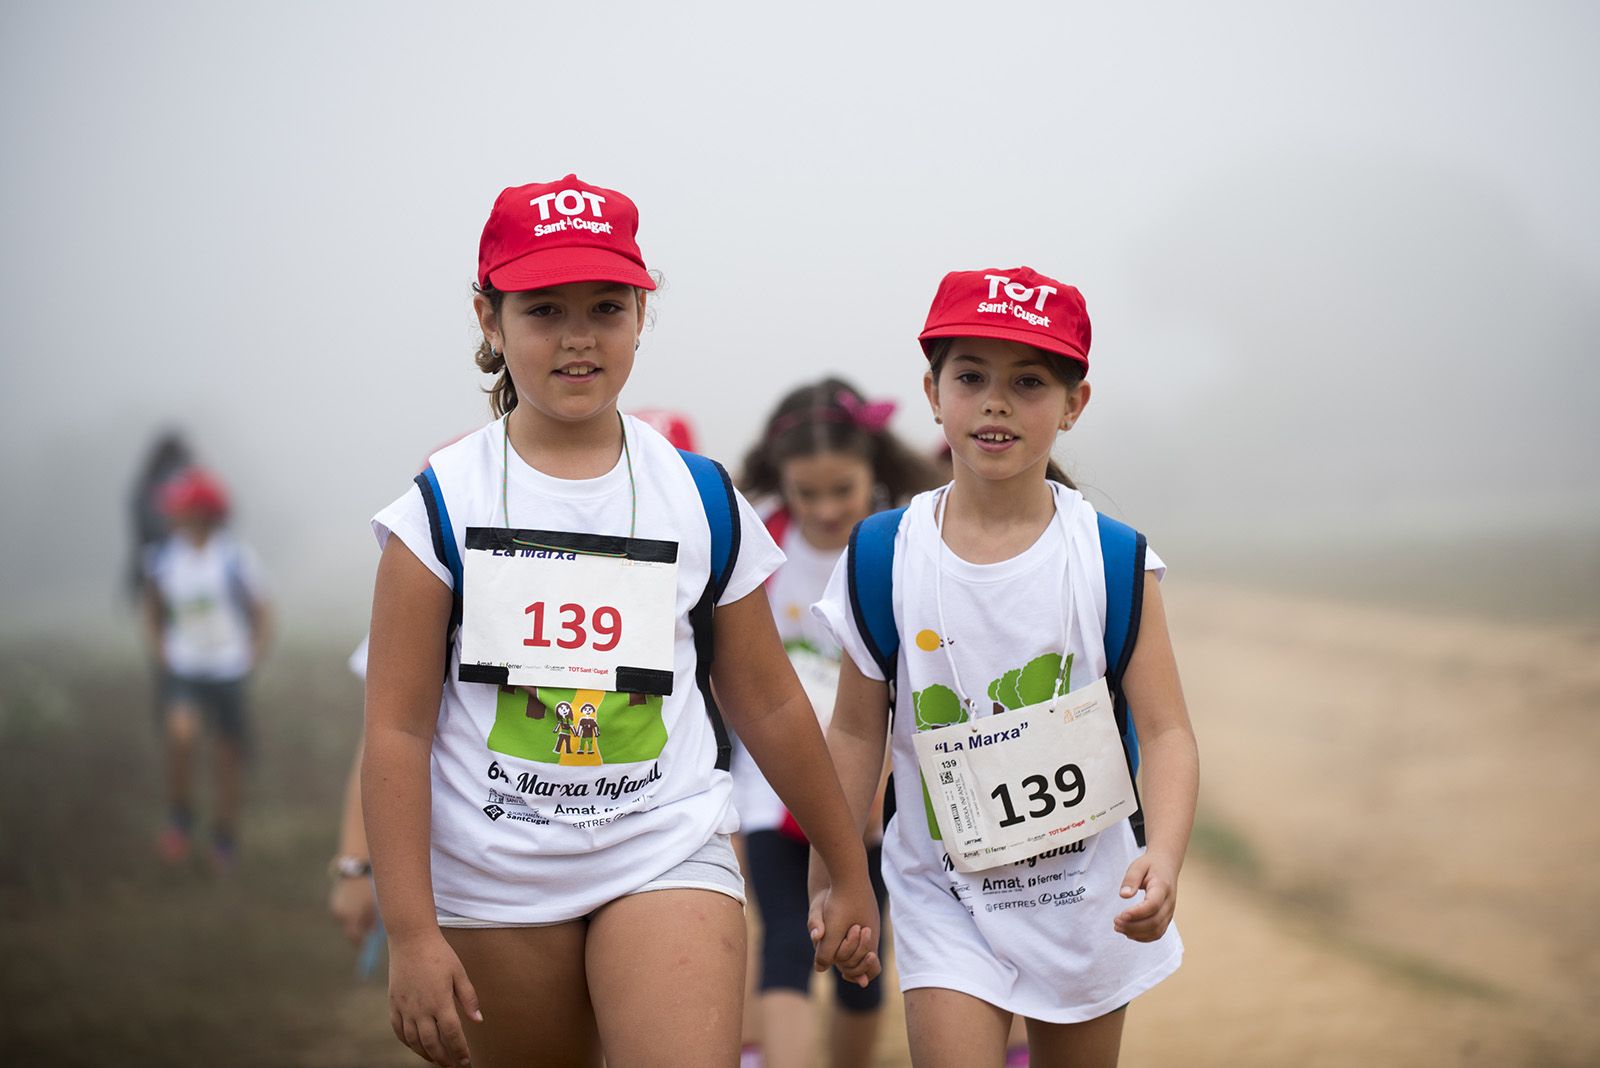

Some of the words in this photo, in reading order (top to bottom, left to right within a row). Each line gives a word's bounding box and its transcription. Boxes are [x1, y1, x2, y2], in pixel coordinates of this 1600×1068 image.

[530, 189, 606, 221] TOT
[534, 219, 567, 237] Sant
[573, 217, 613, 235] Cugat
[984, 274, 1057, 312] TOT
[977, 301, 1008, 314] Sant
[1013, 305, 1051, 328] Cugat
[523, 601, 623, 652] 139
[941, 759, 957, 769] 139
[516, 772, 590, 798] Marxa
[990, 763, 1086, 828] 139
[554, 803, 600, 815] Amat.
[982, 877, 1025, 893] Amat.
[1037, 872, 1063, 885] ferrer
[993, 899, 1037, 911] FERTRES
[1053, 886, 1086, 900] LEXUS
